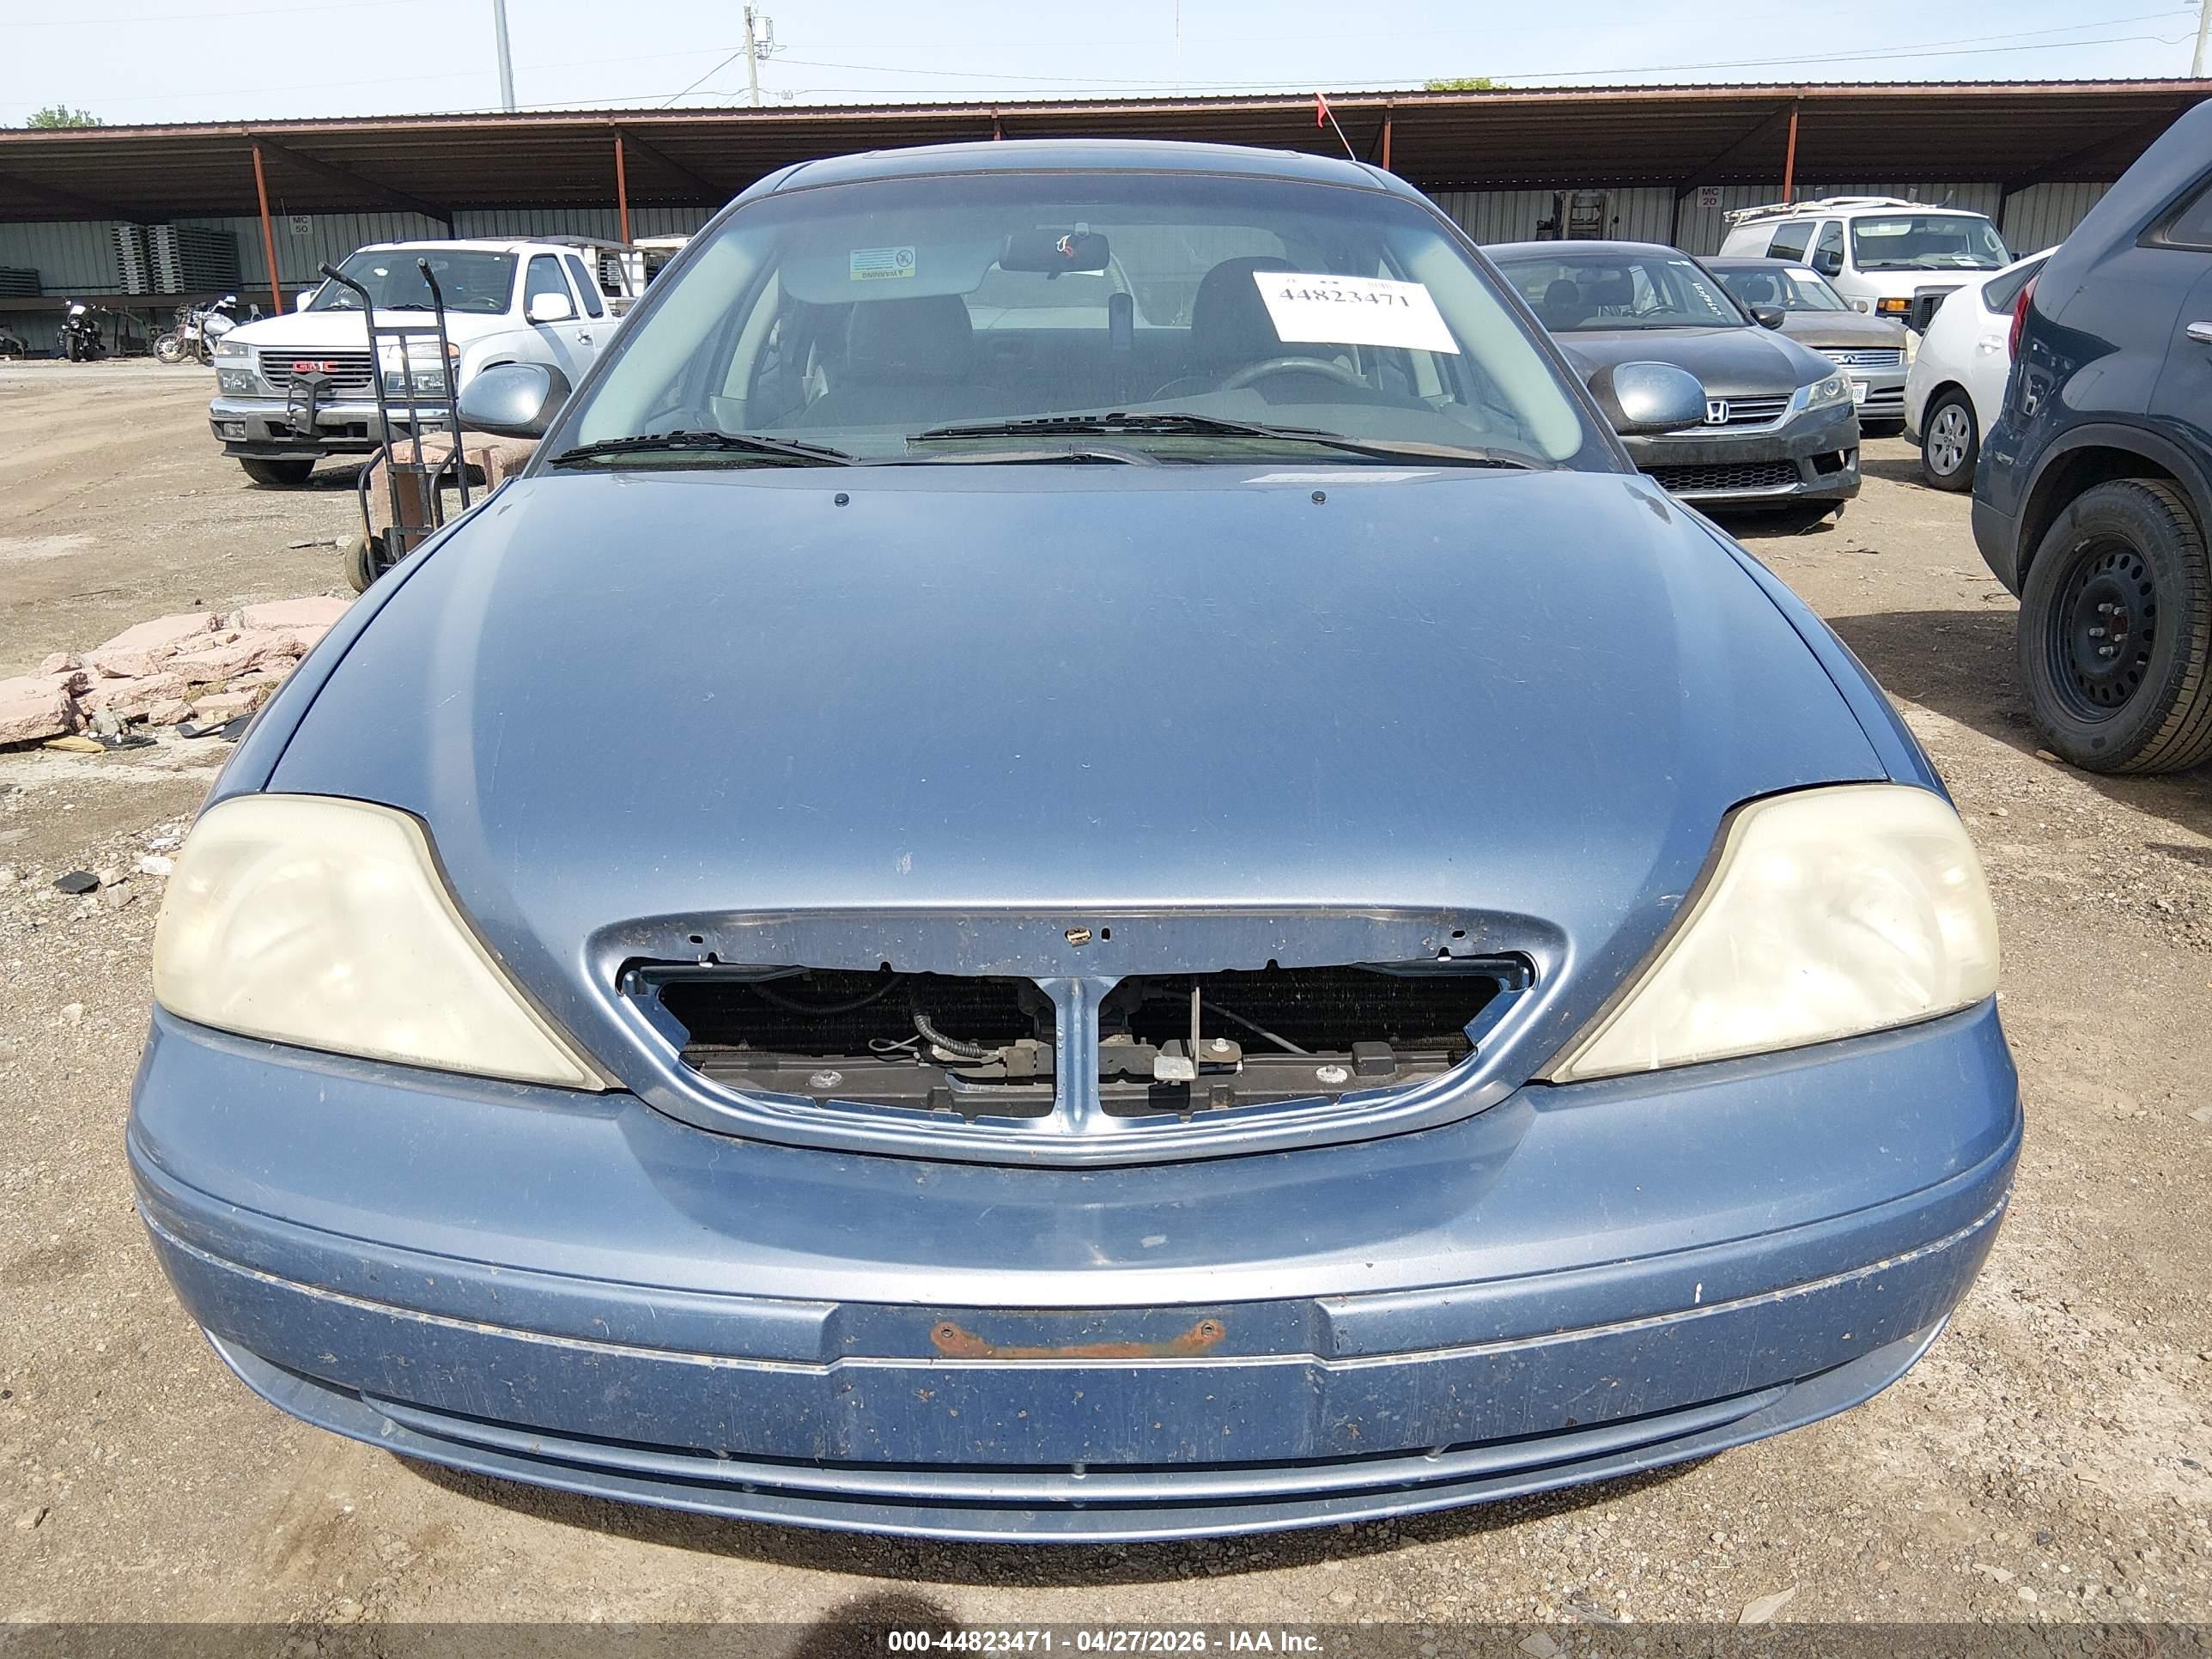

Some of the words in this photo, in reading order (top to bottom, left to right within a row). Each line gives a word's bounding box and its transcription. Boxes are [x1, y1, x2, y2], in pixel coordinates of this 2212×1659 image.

[1702, 187, 1719, 196] MC
[293, 216, 308, 224] MC
[861, 270, 898, 280] WARNING
[1279, 288, 1410, 307] 44823471
[292, 361, 339, 372] GMC
